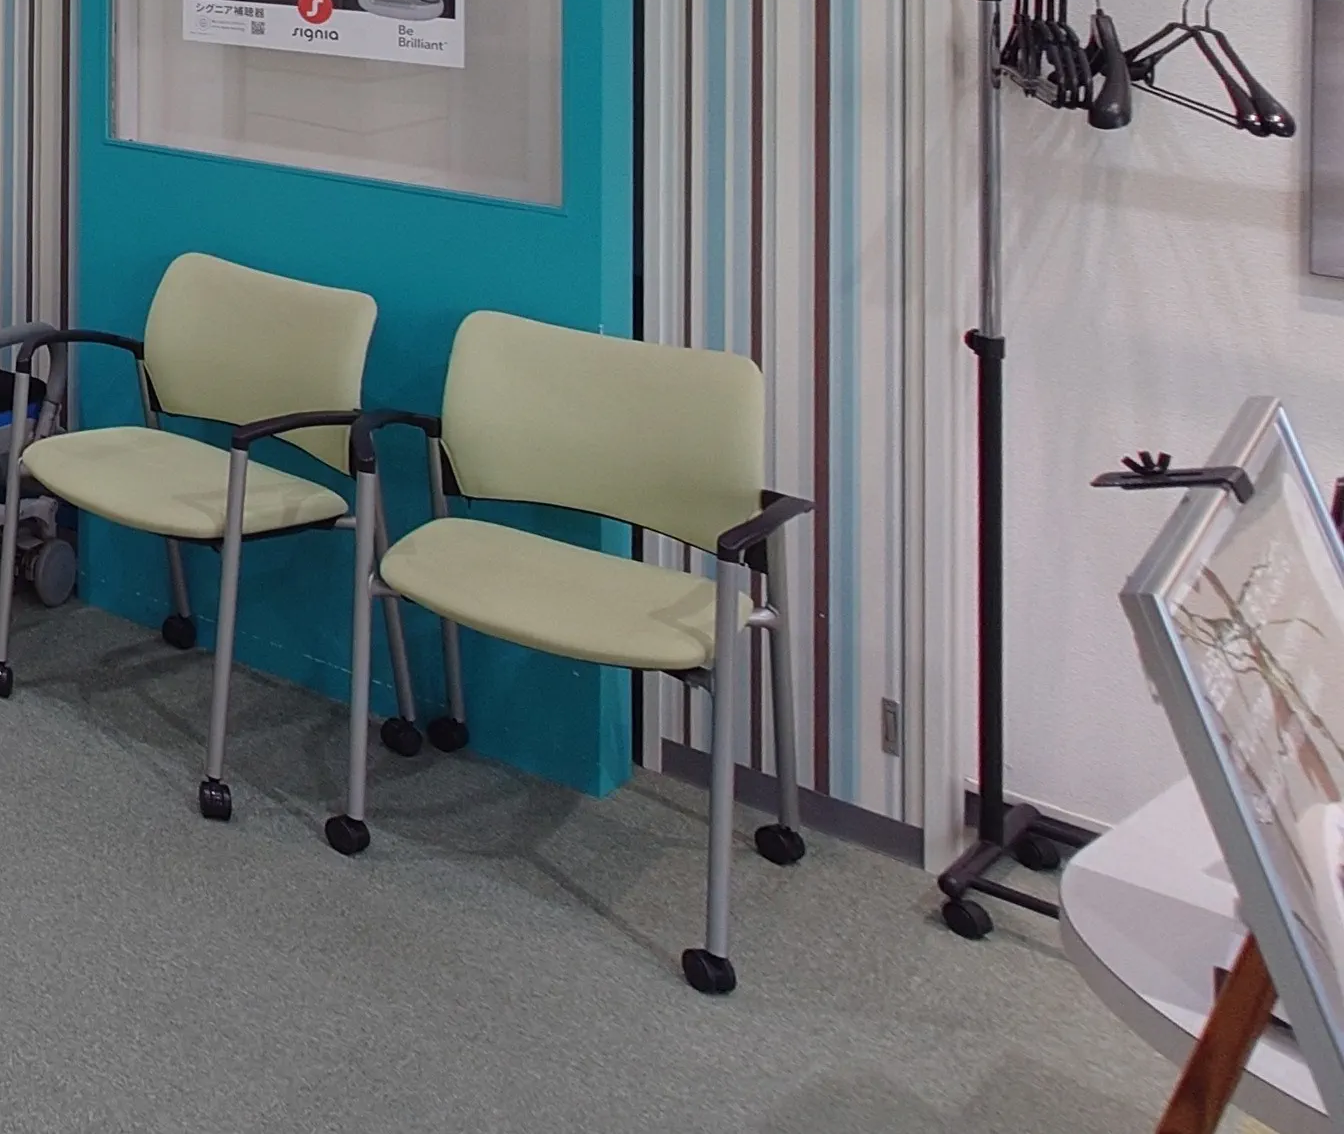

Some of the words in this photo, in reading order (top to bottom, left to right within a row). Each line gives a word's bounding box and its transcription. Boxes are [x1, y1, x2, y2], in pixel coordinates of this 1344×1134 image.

[195, 2, 265, 18] シグニア補聴器
[291, 27, 339, 42] signia
[398, 24, 414, 36] Be
[398, 37, 444, 51] Brilliant
